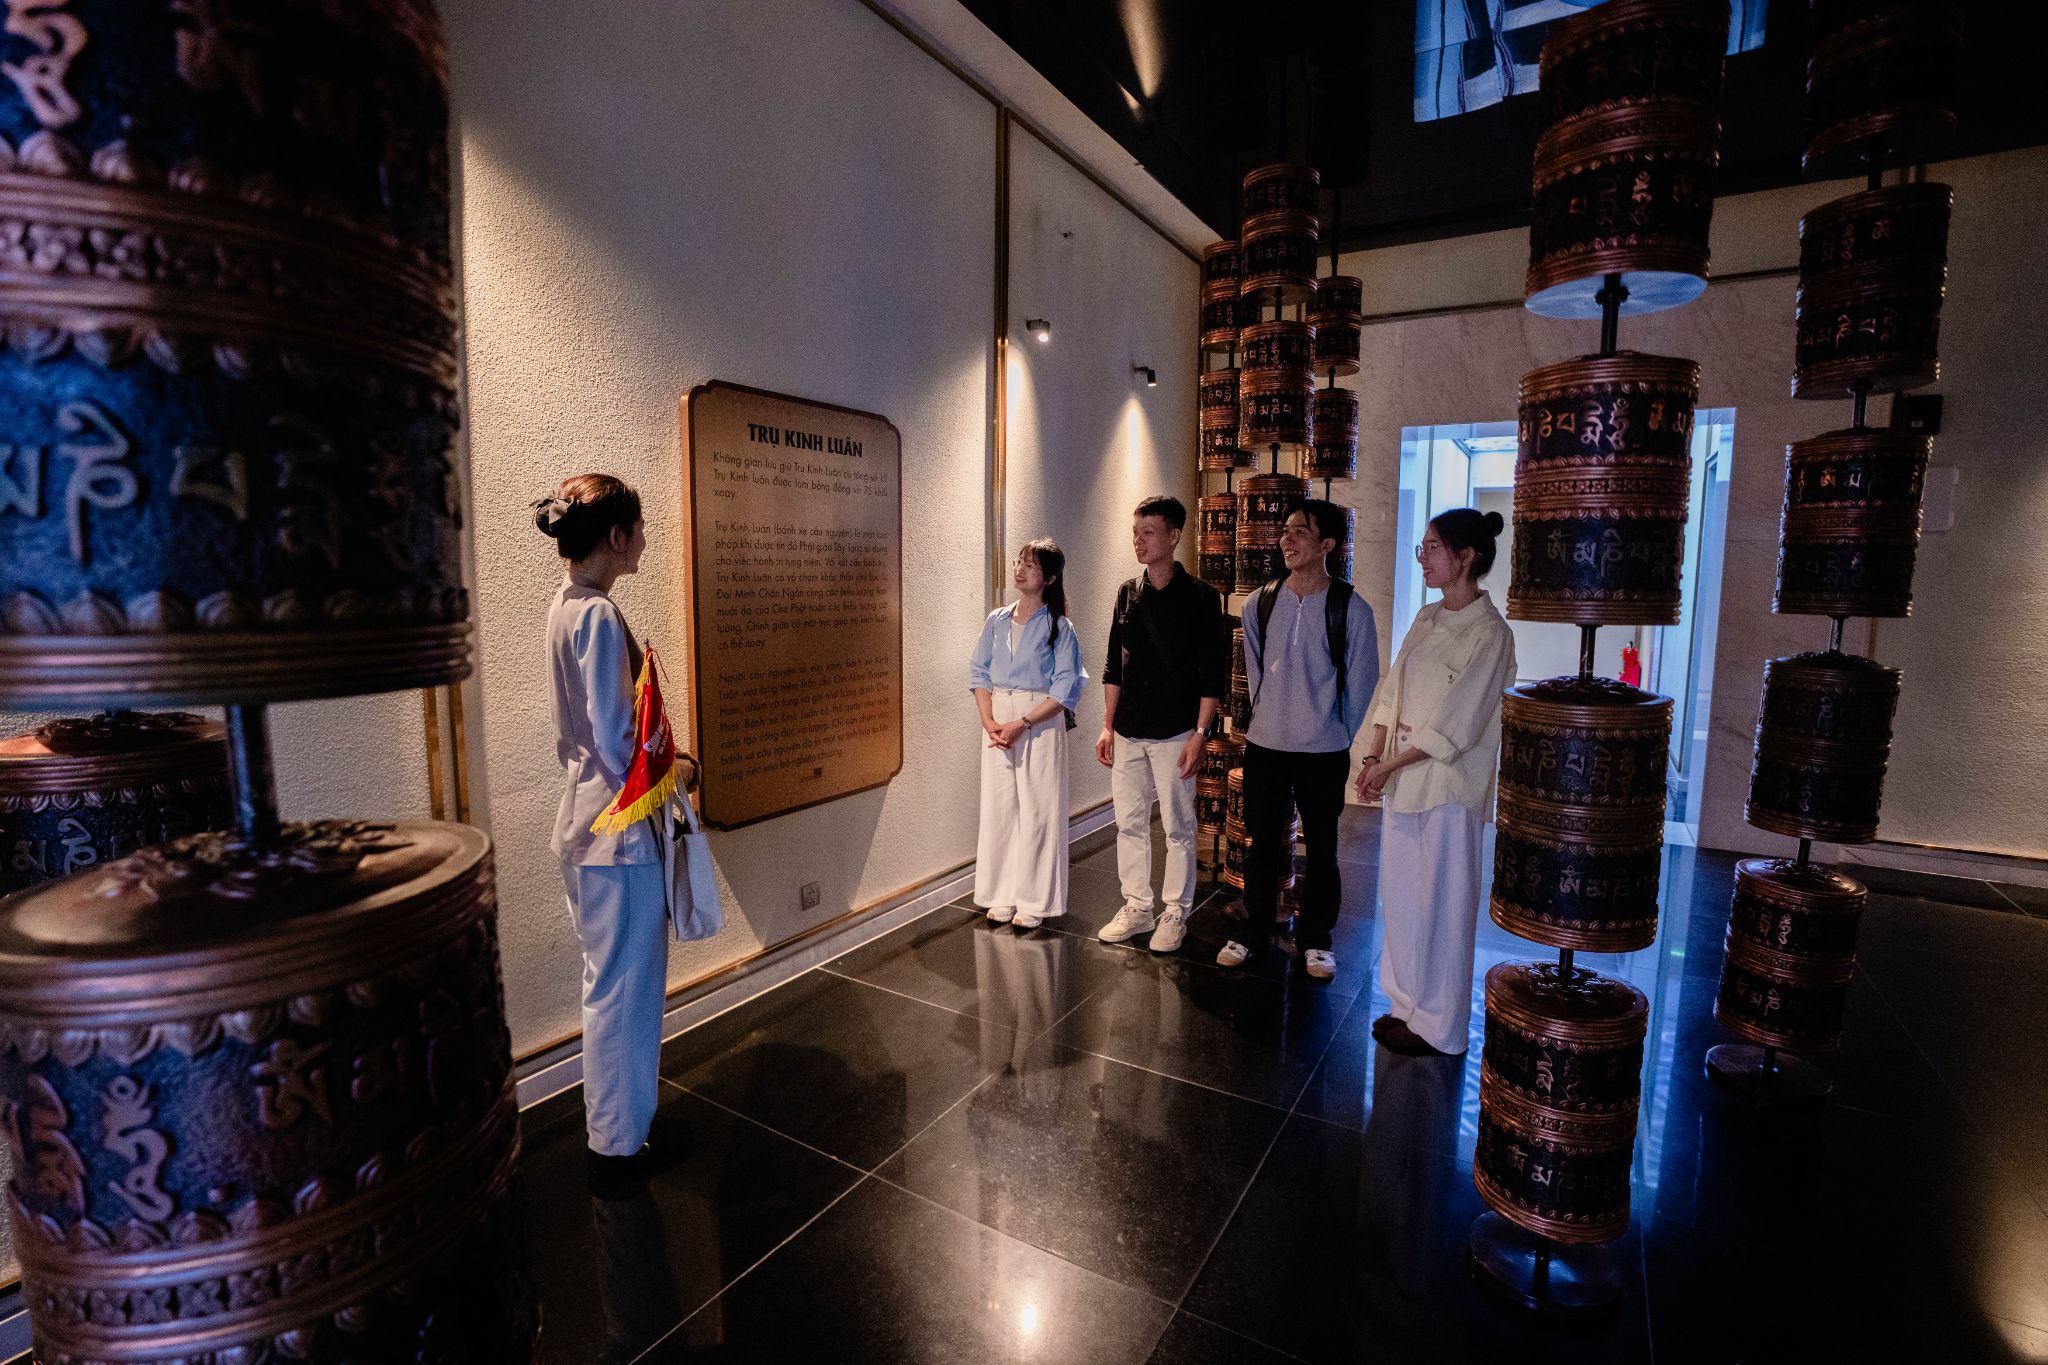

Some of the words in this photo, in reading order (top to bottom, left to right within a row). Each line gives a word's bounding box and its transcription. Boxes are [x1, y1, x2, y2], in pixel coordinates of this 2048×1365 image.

[748, 423, 779, 448] TRỤ
[785, 429, 823, 451] KINH
[828, 437, 863, 457] LUÂN
[713, 451, 741, 468] Không
[745, 458, 763, 469] gian
[808, 464, 823, 474] Kinh
[713, 468, 726, 482] Trụ
[730, 470, 749, 482] Kinh
[715, 520, 728, 534] Trụ
[731, 521, 749, 532] Kinh
[715, 554, 732, 566] cho
[734, 556, 751, 567] việc
[732, 571, 750, 582] Kinh
[717, 588, 732, 601] Đại
[735, 588, 756, 599] Minh
